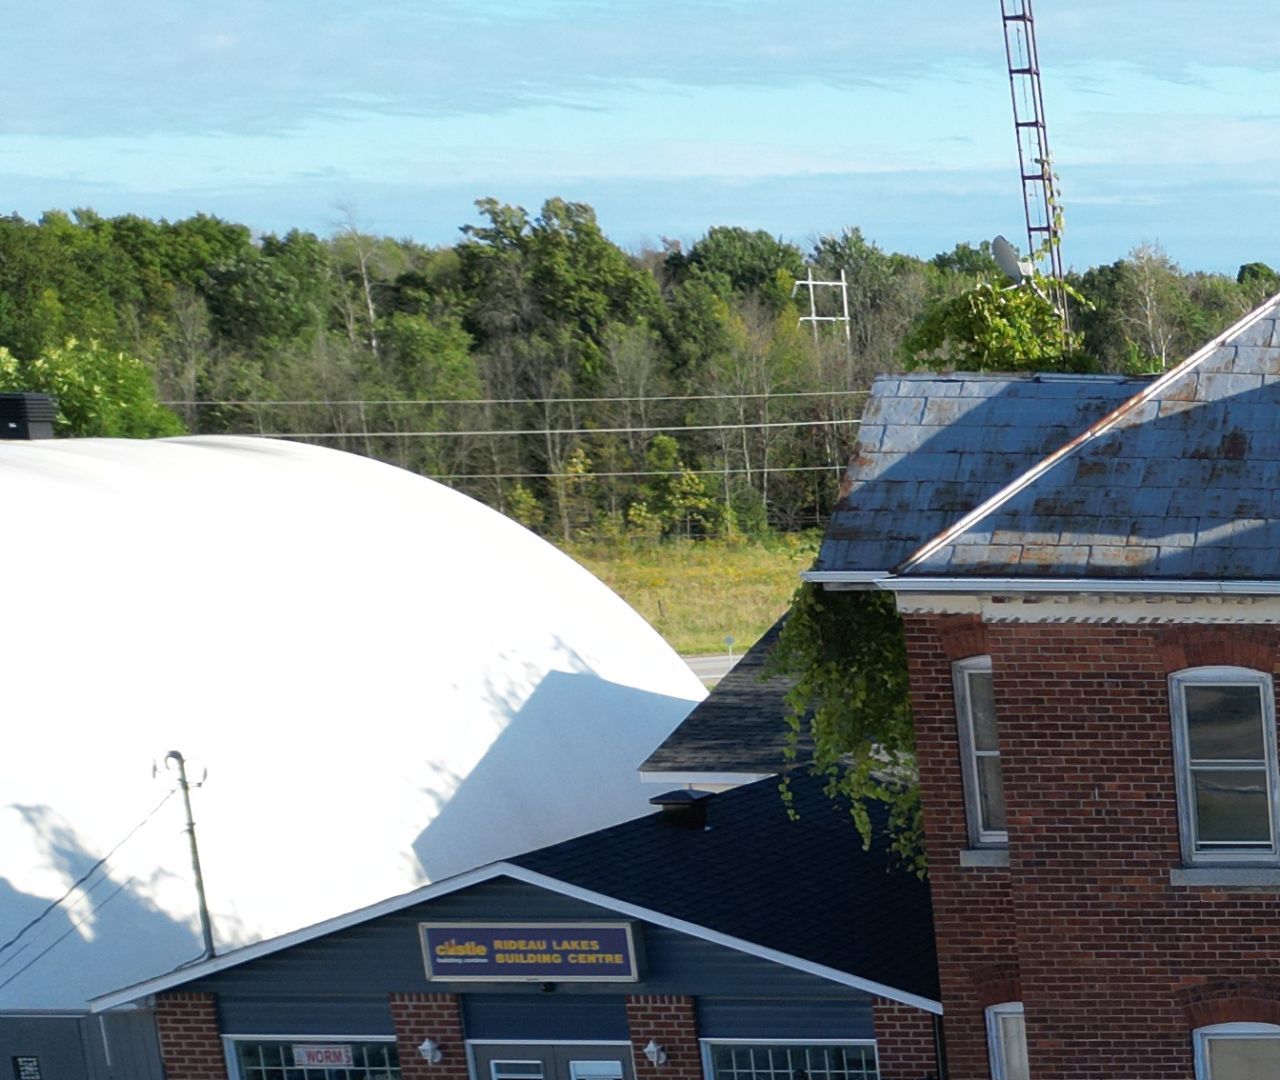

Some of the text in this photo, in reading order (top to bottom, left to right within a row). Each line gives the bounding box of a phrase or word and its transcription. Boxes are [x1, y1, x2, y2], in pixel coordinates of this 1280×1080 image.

[493, 940, 599, 950] RIDEAU LAKES
[495, 954, 624, 964] BUILDING CENTRE
[306, 1049, 352, 1064] WORMS
